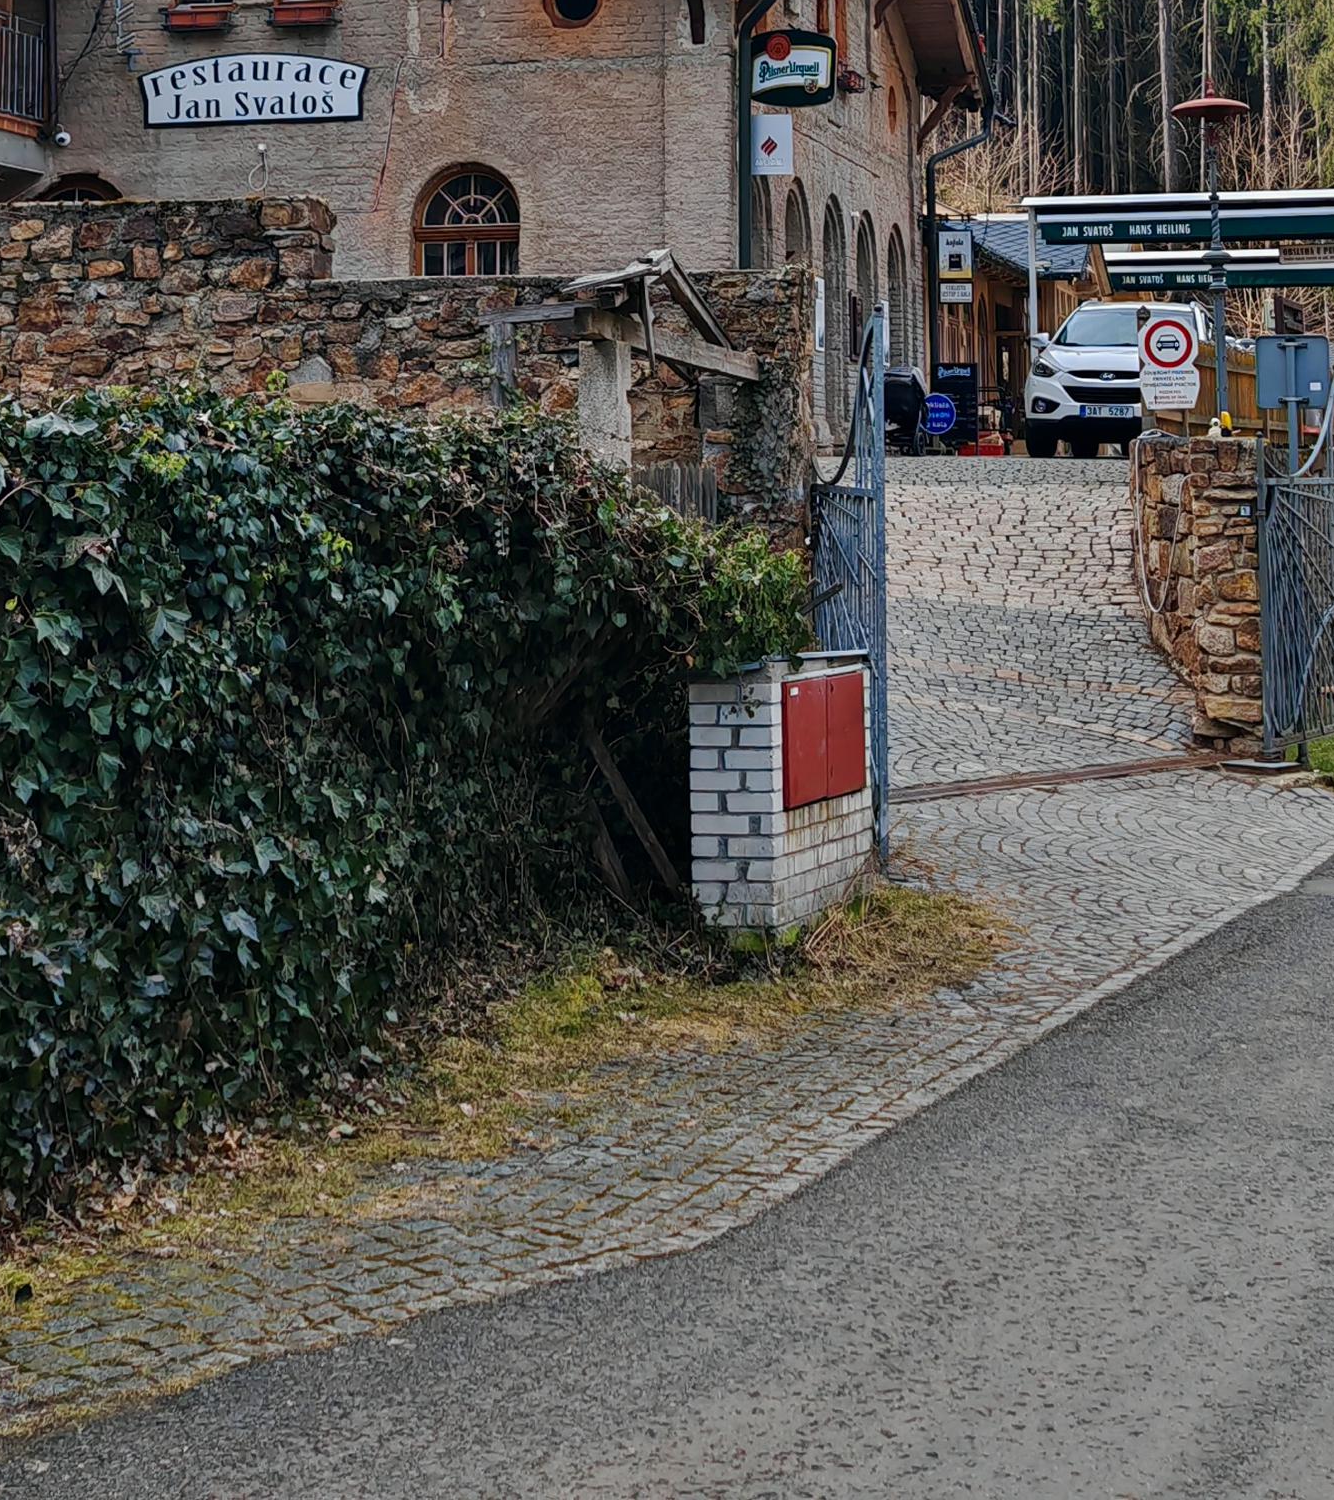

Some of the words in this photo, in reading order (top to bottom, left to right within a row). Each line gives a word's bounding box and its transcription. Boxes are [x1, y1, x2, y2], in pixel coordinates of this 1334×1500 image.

[150, 58, 357, 97] restaurace
[759, 60, 789, 83] Pilsner
[788, 60, 820, 77] Urquell
[166, 93, 222, 120] Jan
[234, 90, 335, 117] Svatoš
[1062, 225, 1079, 238] JAN
[1082, 223, 1114, 237] SVATOŠ
[1129, 224, 1152, 236] HANS
[1156, 223, 1191, 235] HEILING
[1122, 275, 1136, 285] JAN
[1139, 273, 1165, 285] SVATOŠ
[1176, 274, 1196, 284] HANS
[1087, 406, 1102, 416] 3AT
[1108, 406, 1130, 417] 5287
